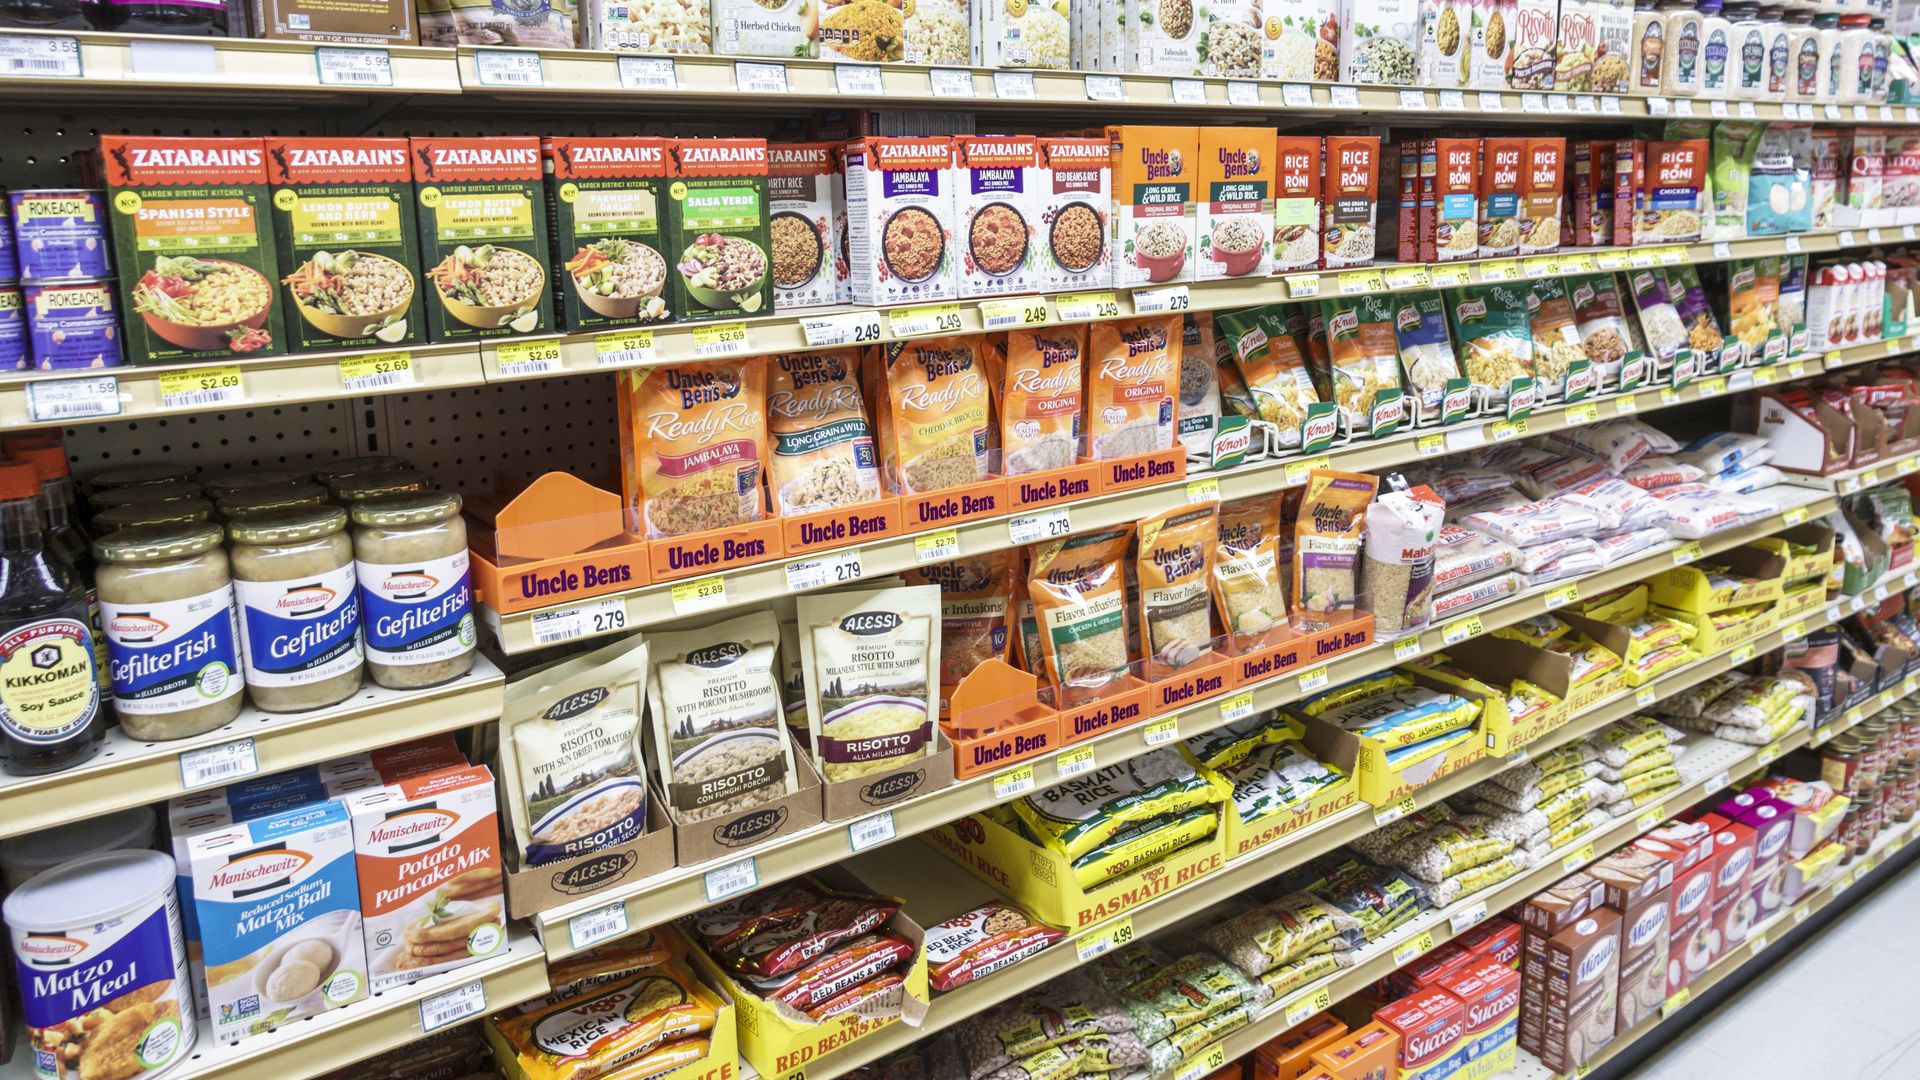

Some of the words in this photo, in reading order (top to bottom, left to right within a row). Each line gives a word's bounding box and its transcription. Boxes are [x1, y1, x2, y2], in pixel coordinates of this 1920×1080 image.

[740, 21, 768, 32] Herbed
[770, 22, 801, 32] Chicken
[49, 41, 78, 52] 3.59
[365, 57, 388, 66] 5.99
[518, 58, 538, 67] 8.59
[655, 63, 673, 72] 3.29
[132, 149, 261, 166] ZATARAIN'S
[290, 150, 406, 166] ZATARAIN'S
[573, 148, 662, 162] ZATARAIN'S
[683, 148, 765, 161] ZATARAIN'S
[881, 144, 948, 157] ZATARAIN'S
[1050, 144, 1110, 157] ZATARAIN'S
[1142, 148, 1169, 164] Uncle
[1343, 151, 1368, 165] RICE
[1662, 152, 1693, 163] RICE
[1285, 156, 1308, 168] RICE
[892, 172, 930, 183] JAMBALAYA
[1148, 164, 1171, 180] Ben's
[1342, 173, 1368, 186] RONI
[1660, 168, 1692, 180] RONI
[1285, 175, 1308, 187] RONI
[142, 189, 172, 197] GARDEN
[175, 189, 209, 197] DISTRICT
[30, 201, 81, 215] ROKEACH
[303, 203, 342, 212] LEMON
[347, 202, 390, 211] BUTTER
[688, 197, 718, 207] SALSA
[722, 196, 754, 205] VERDE
[139, 208, 204, 220] SPANISH
[208, 208, 250, 218] STYLE
[1170, 296, 1188, 310] 2.79
[720, 332, 745, 342] $2.69
[855, 325, 880, 342] 2.49
[375, 360, 408, 373] $2.69
[88, 383, 115, 394] 1.59
[201, 376, 238, 390] $2.69
[1124, 386, 1164, 398] ORIGINAL
[1511, 394, 1534, 408] Knorr
[648, 410, 719, 443] Ready
[720, 403, 760, 431] Rice
[1375, 408, 1402, 424] Knorr
[786, 434, 813, 448] LONG
[813, 427, 840, 441] GRAIN
[844, 422, 866, 437] WILD
[919, 420, 953, 436] CHEDDAR
[1216, 435, 1249, 455] Knorr
[684, 444, 740, 470] JAMBALAYA
[1113, 464, 1145, 483] Uncle
[1147, 460, 1175, 477] Ben's
[1048, 519, 1069, 536] 2.79
[522, 570, 581, 598] Uncle
[583, 563, 631, 588] Ben's
[698, 585, 723, 598] $2.89
[952, 603, 1002, 615] Infusions
[1055, 609, 1086, 623] Flavor
[594, 610, 625, 632] 2.79
[845, 614, 897, 631] ALESSI
[413, 637, 433, 649] JELLED
[434, 629, 452, 643] BROTH
[692, 644, 742, 665] ALESSI
[851, 652, 895, 663] RISOTTO
[826, 663, 855, 675] MILANESE
[857, 663, 874, 672] STYLE
[877, 661, 894, 670] WITH
[895, 657, 920, 668] SAFFRON
[5, 663, 87, 689] KIKKOMAN
[20, 700, 45, 712] Soy
[49, 691, 85, 707] Sauce
[550, 688, 604, 718] ALESSI
[1417, 723, 1444, 738] JASMINE
[1445, 717, 1458, 729] RICE
[560, 727, 603, 753] RISOTTO
[846, 735, 911, 753] RISOTTO
[228, 742, 253, 755] 9.29
[533, 764, 556, 776] WITH
[558, 754, 572, 766] SUN
[573, 745, 593, 760] DRIED
[594, 730, 632, 749] TOMATOES
[853, 753, 871, 761] ALLA
[872, 747, 906, 758] MILANESE
[702, 767, 765, 794] RISOTTO
[1012, 771, 1031, 782] $3.39
[697, 794, 713, 804] CON
[715, 786, 742, 800] FUNGHI
[743, 776, 771, 789] PORCINI
[1400, 798, 1414, 814] 3.99
[367, 815, 448, 845] Manischewitz
[1133, 844, 1170, 864] BASMATI
[1172, 832, 1191, 849] RICE
[398, 842, 462, 881] Potato
[209, 856, 298, 890] Manischewitz
[375, 863, 455, 908] Pancake
[458, 846, 492, 873] Mix
[1077, 878, 1170, 928] BASMATI
[1177, 853, 1221, 884] RICE
[241, 895, 284, 920] Reduced
[284, 878, 324, 904] Sodium
[236, 905, 297, 938] Matzo
[298, 880, 332, 912] Ball
[605, 904, 624, 916] 2.99
[276, 909, 305, 933] Mix
[1113, 925, 1133, 945] 4.99
[33, 957, 114, 998] Matzo
[812, 983, 834, 1000] RED
[835, 971, 865, 993] BEANS
[866, 966, 874, 977] &
[875, 956, 897, 972] RICE
[71, 962, 137, 1011] Meal
[460, 982, 481, 997] 4.49
[543, 1012, 621, 1046] MEXICAN
[570, 1026, 609, 1050] RICE
[1407, 1021, 1462, 1062] Success
